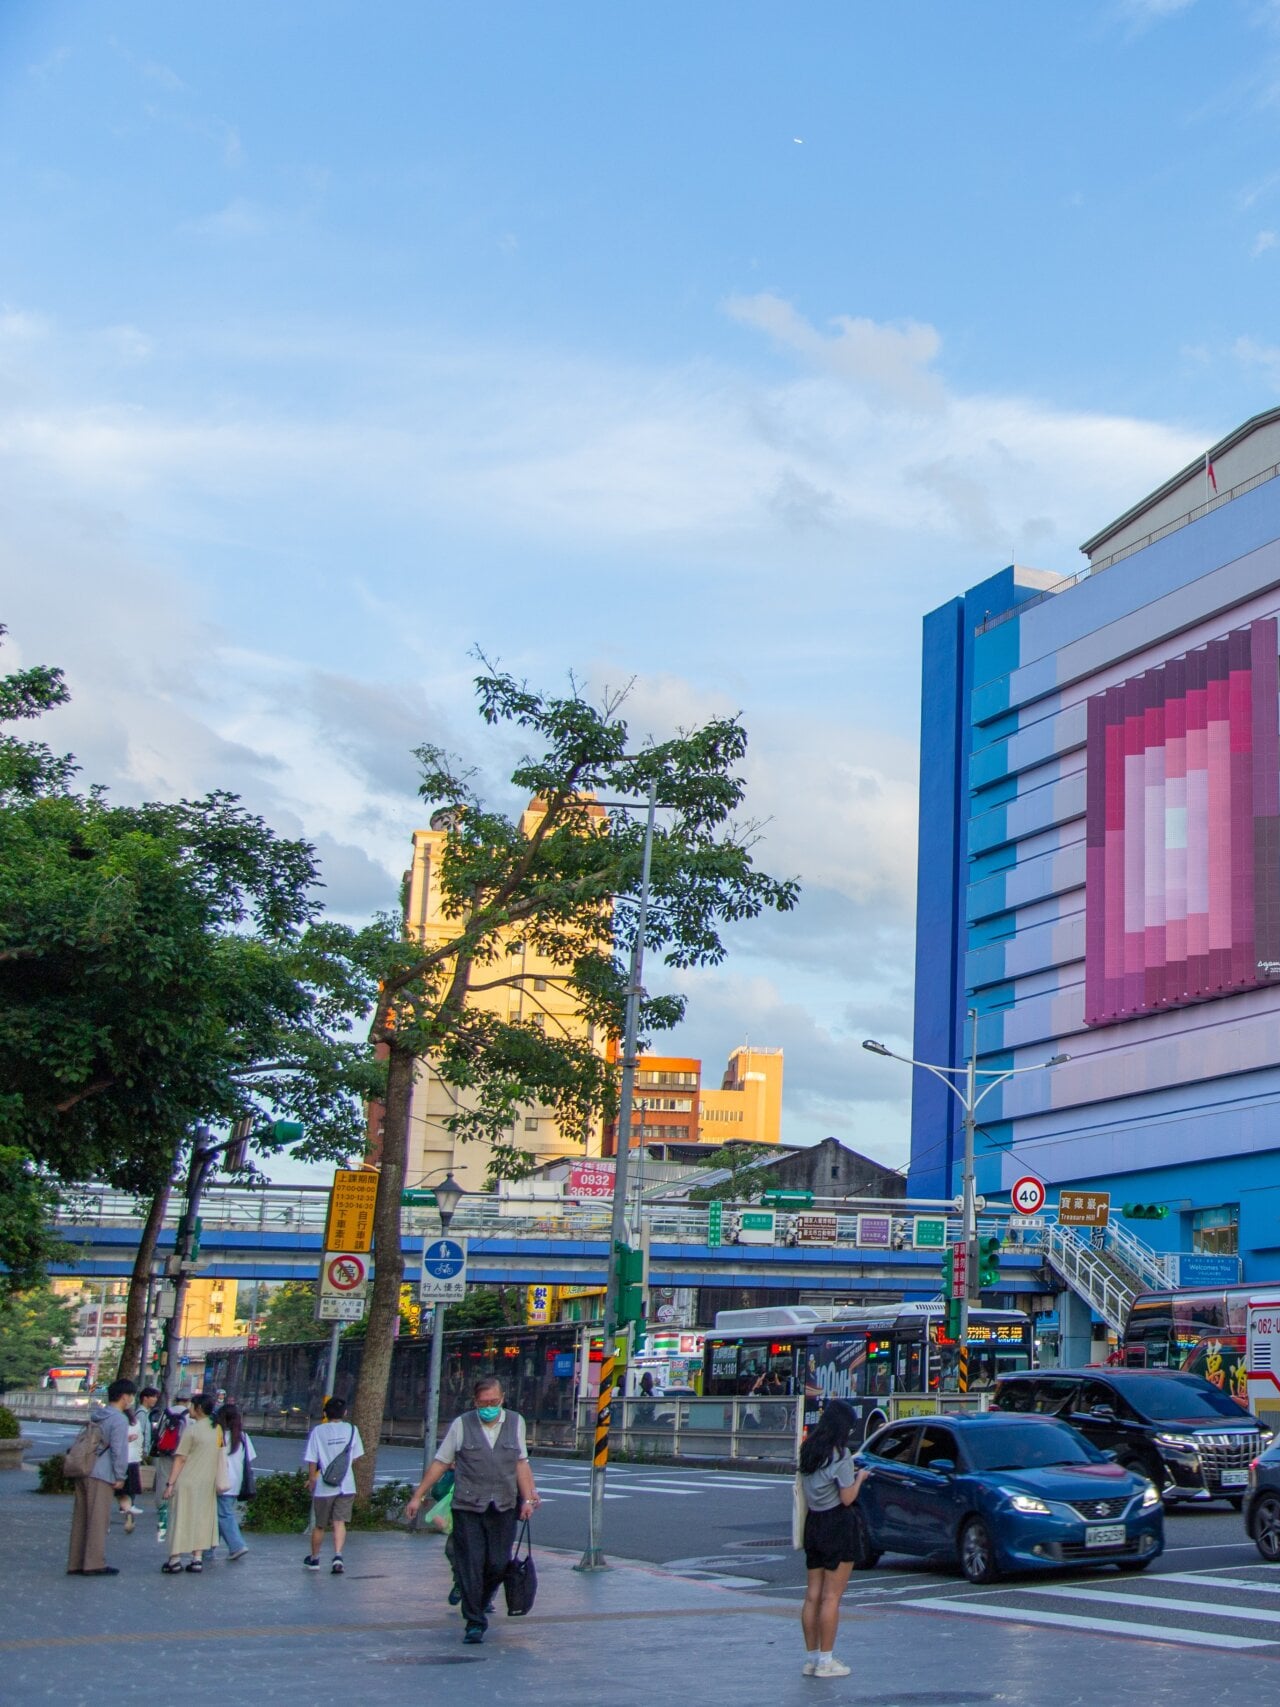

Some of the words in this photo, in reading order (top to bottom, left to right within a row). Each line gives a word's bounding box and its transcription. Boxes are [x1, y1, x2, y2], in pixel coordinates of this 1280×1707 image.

[339, 1173, 377, 1184] 上課期間
[580, 1175, 610, 1186] 0932
[1020, 1190, 1038, 1203] 40
[1061, 1197, 1097, 1210] 寶藏巖
[1061, 1213, 1084, 1221] Treasure
[423, 1282, 463, 1292] 行人優先
[712, 1361, 737, 1376] EAL-1101
